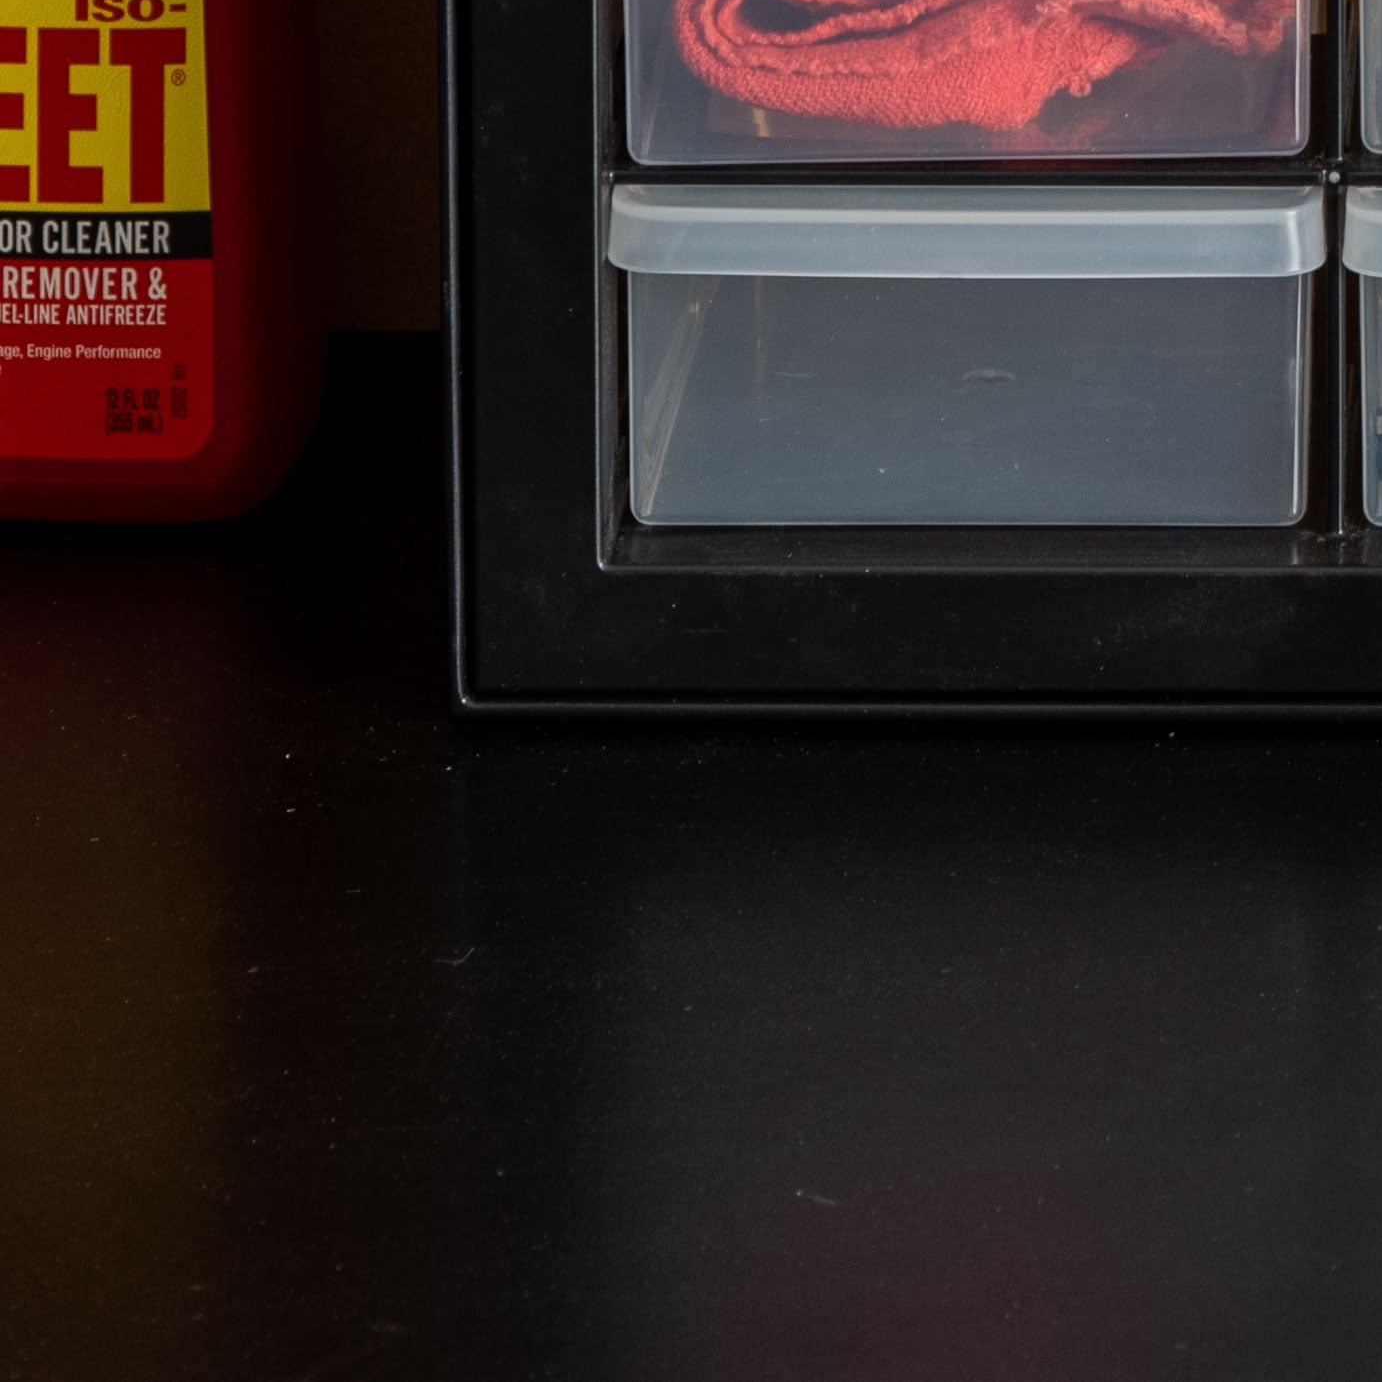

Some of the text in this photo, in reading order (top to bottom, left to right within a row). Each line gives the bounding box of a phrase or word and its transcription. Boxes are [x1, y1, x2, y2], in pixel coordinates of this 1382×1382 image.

[41, 220, 171, 254] CLEANER
[2, 265, 168, 301] REMOVER &
[0, 302, 167, 326] EL-LINE ANTIFREEZE
[26, 343, 72, 361] Engine
[75, 344, 162, 360] Performance
[104, 388, 161, 410] 12 FL OZ
